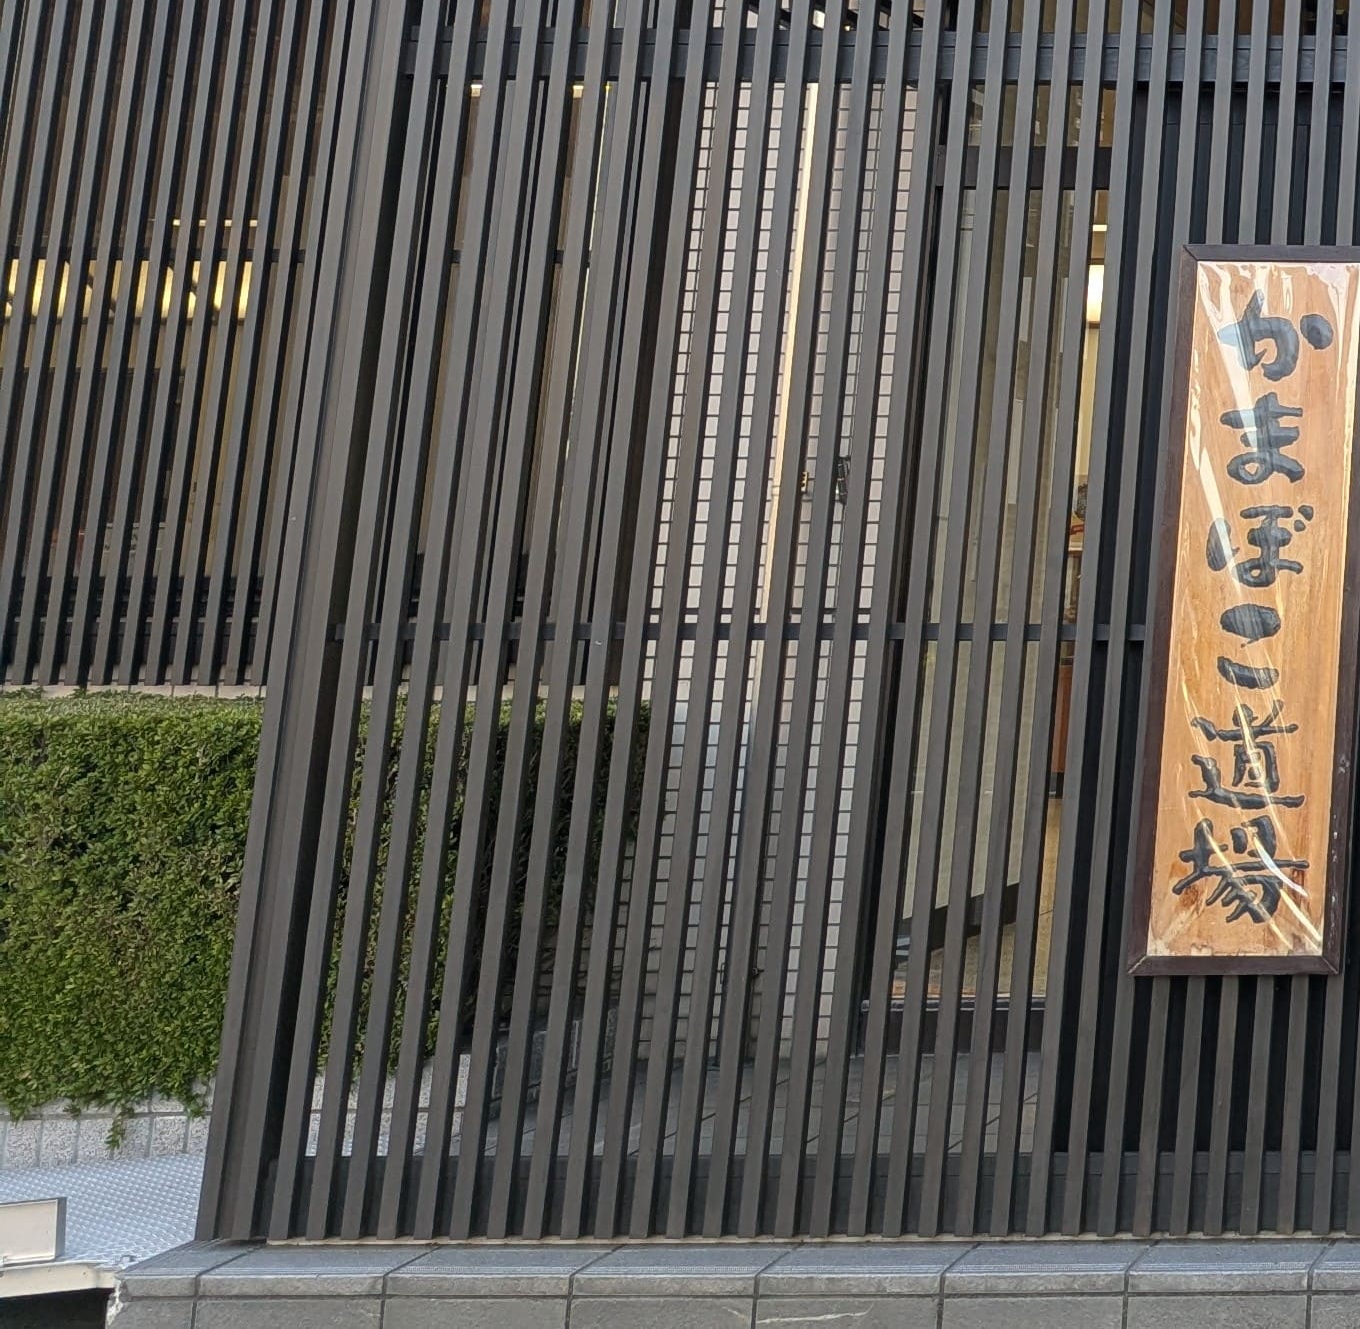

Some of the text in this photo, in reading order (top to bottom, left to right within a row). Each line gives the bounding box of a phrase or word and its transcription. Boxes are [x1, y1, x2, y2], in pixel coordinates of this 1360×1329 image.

[1171, 288, 1334, 925] かまぼこ道場
